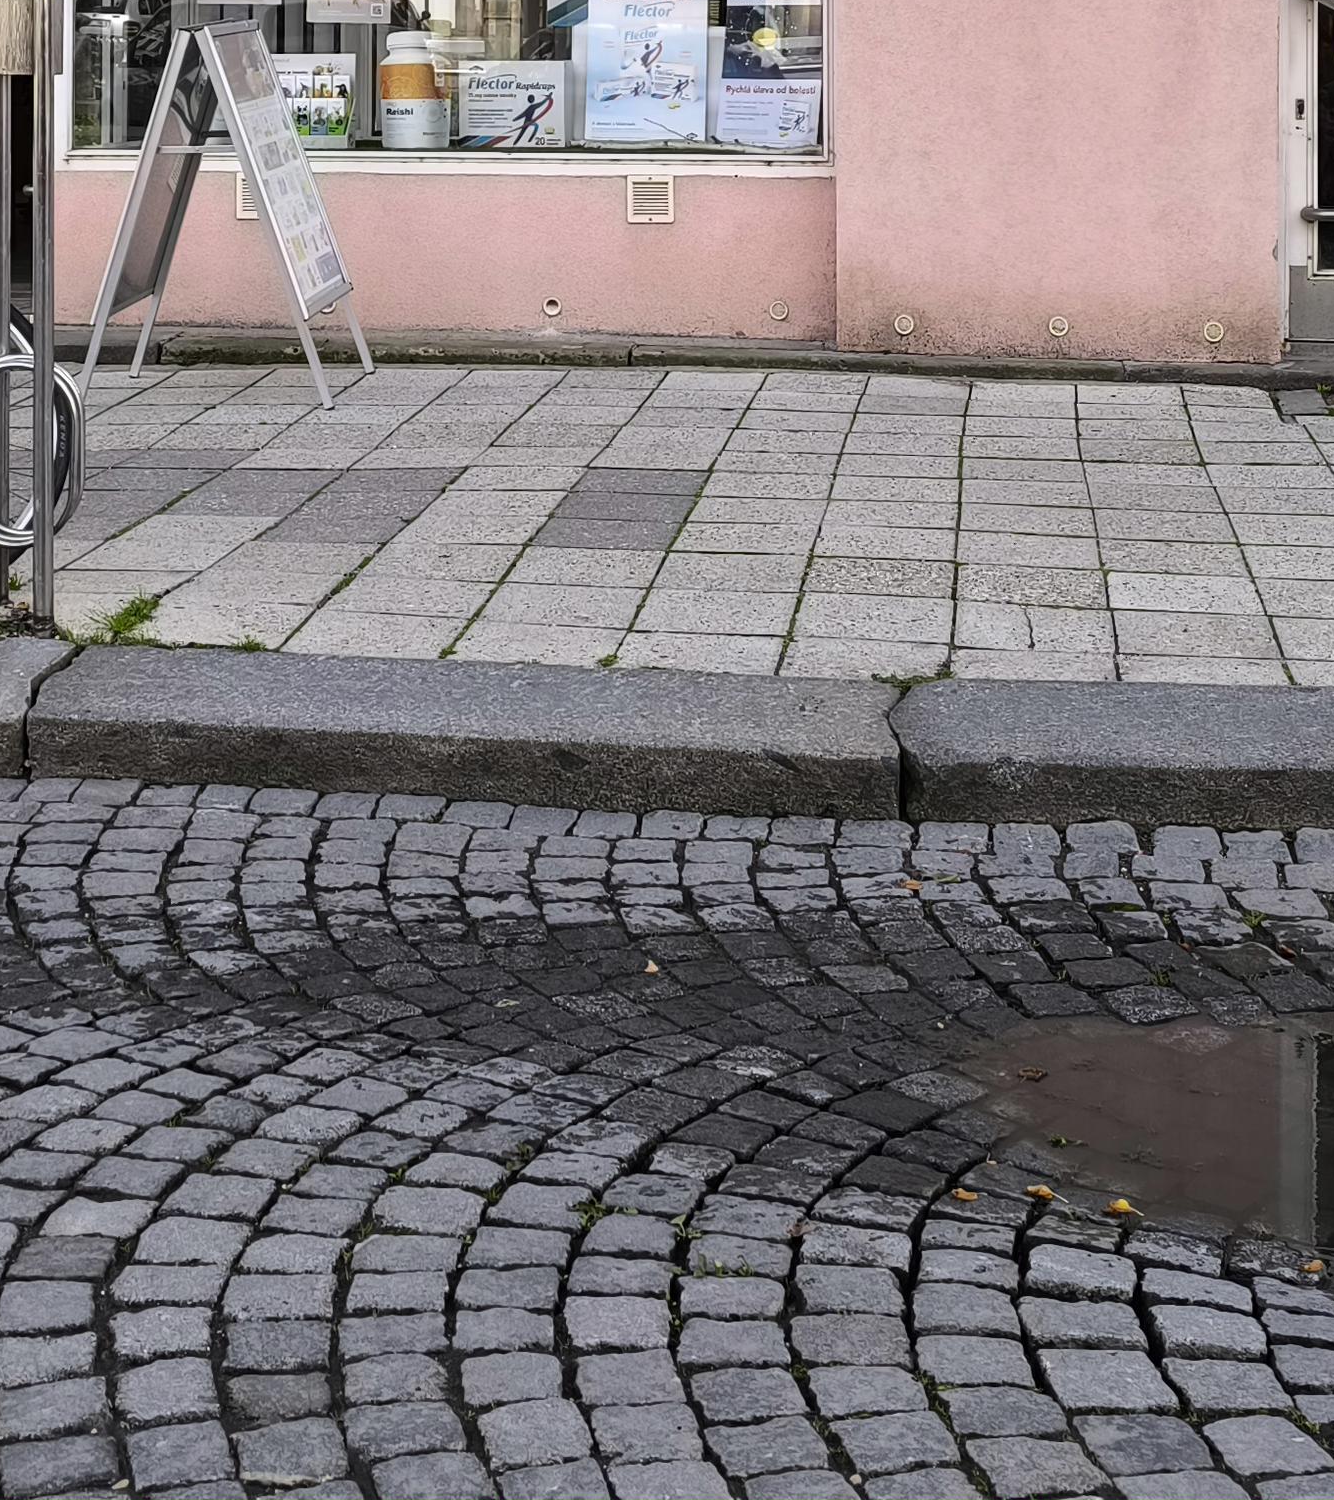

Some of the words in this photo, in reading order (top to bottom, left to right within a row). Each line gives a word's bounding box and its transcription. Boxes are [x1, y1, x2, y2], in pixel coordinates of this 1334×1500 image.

[624, 3, 673, 17] Flector
[624, 30, 659, 41] Flector
[468, 77, 515, 90] Flector
[776, 85, 787, 95] od
[386, 107, 414, 116] Reishi
[535, 137, 545, 146] 20
